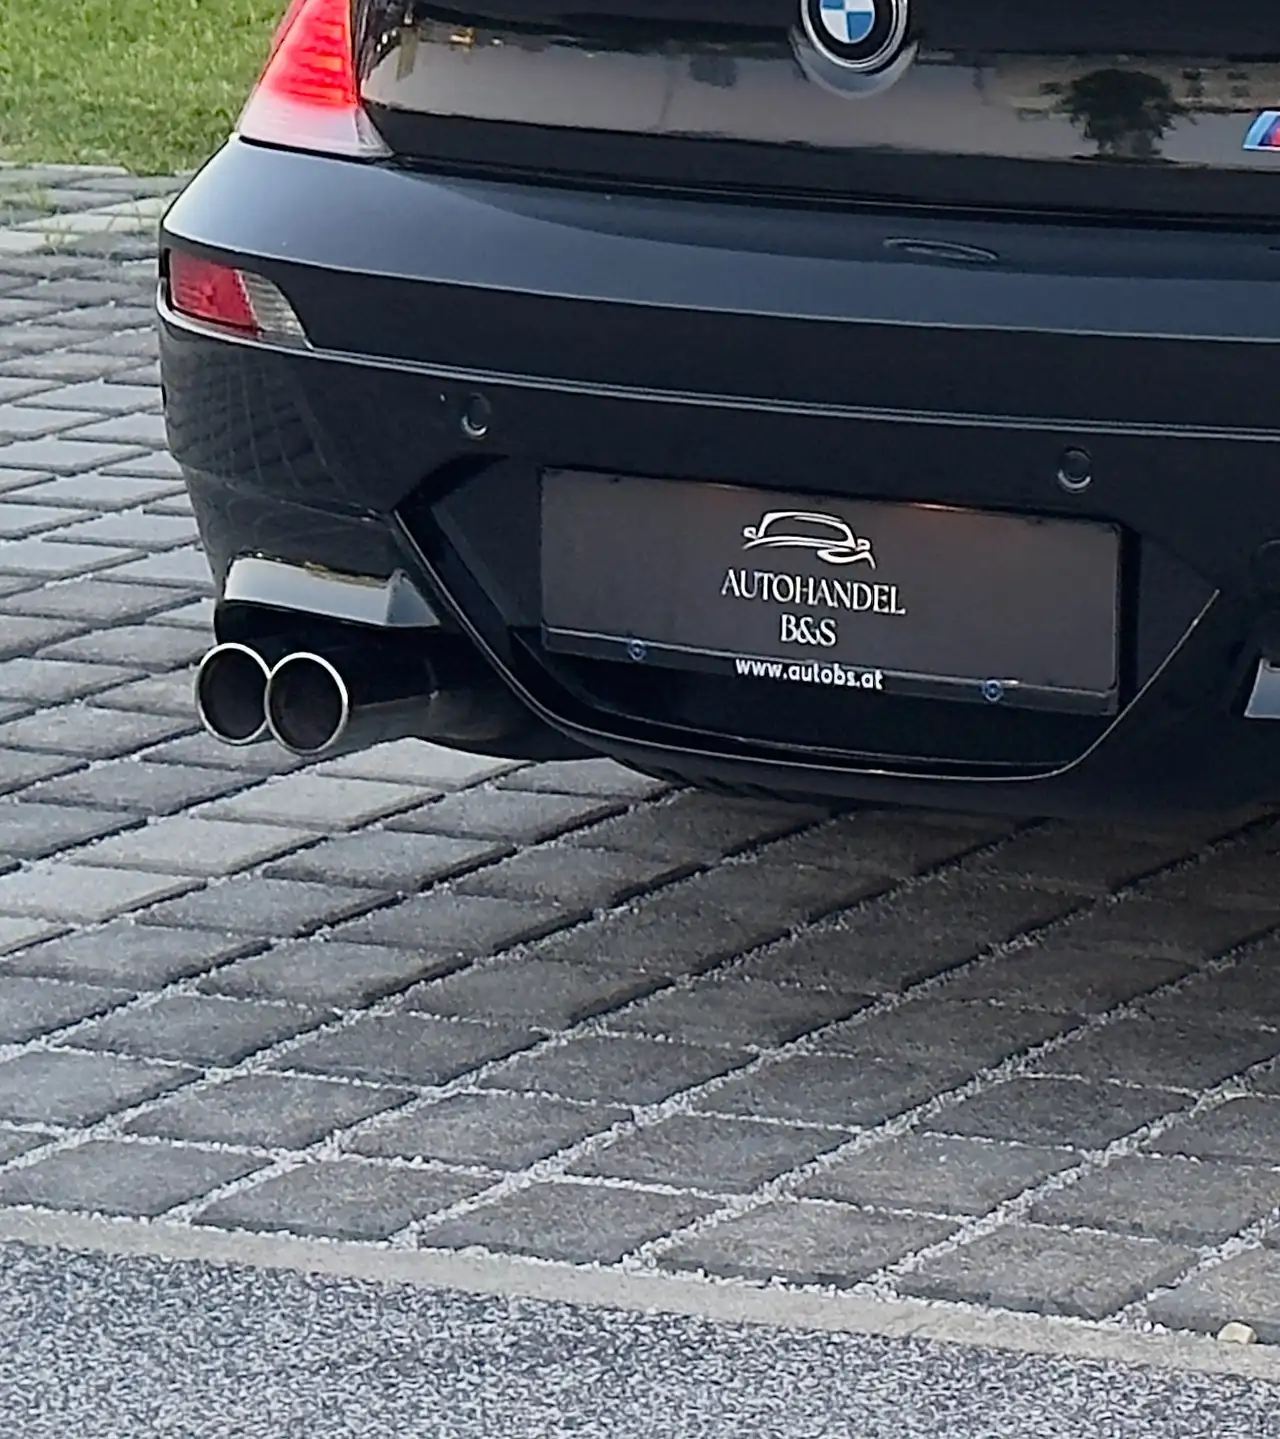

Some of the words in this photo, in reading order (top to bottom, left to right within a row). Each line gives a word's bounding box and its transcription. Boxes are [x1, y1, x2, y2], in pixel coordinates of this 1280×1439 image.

[721, 568, 906, 615] AUTOHANDEL
[780, 614, 837, 646] B&S
[735, 658, 884, 691] www.autobs.at
